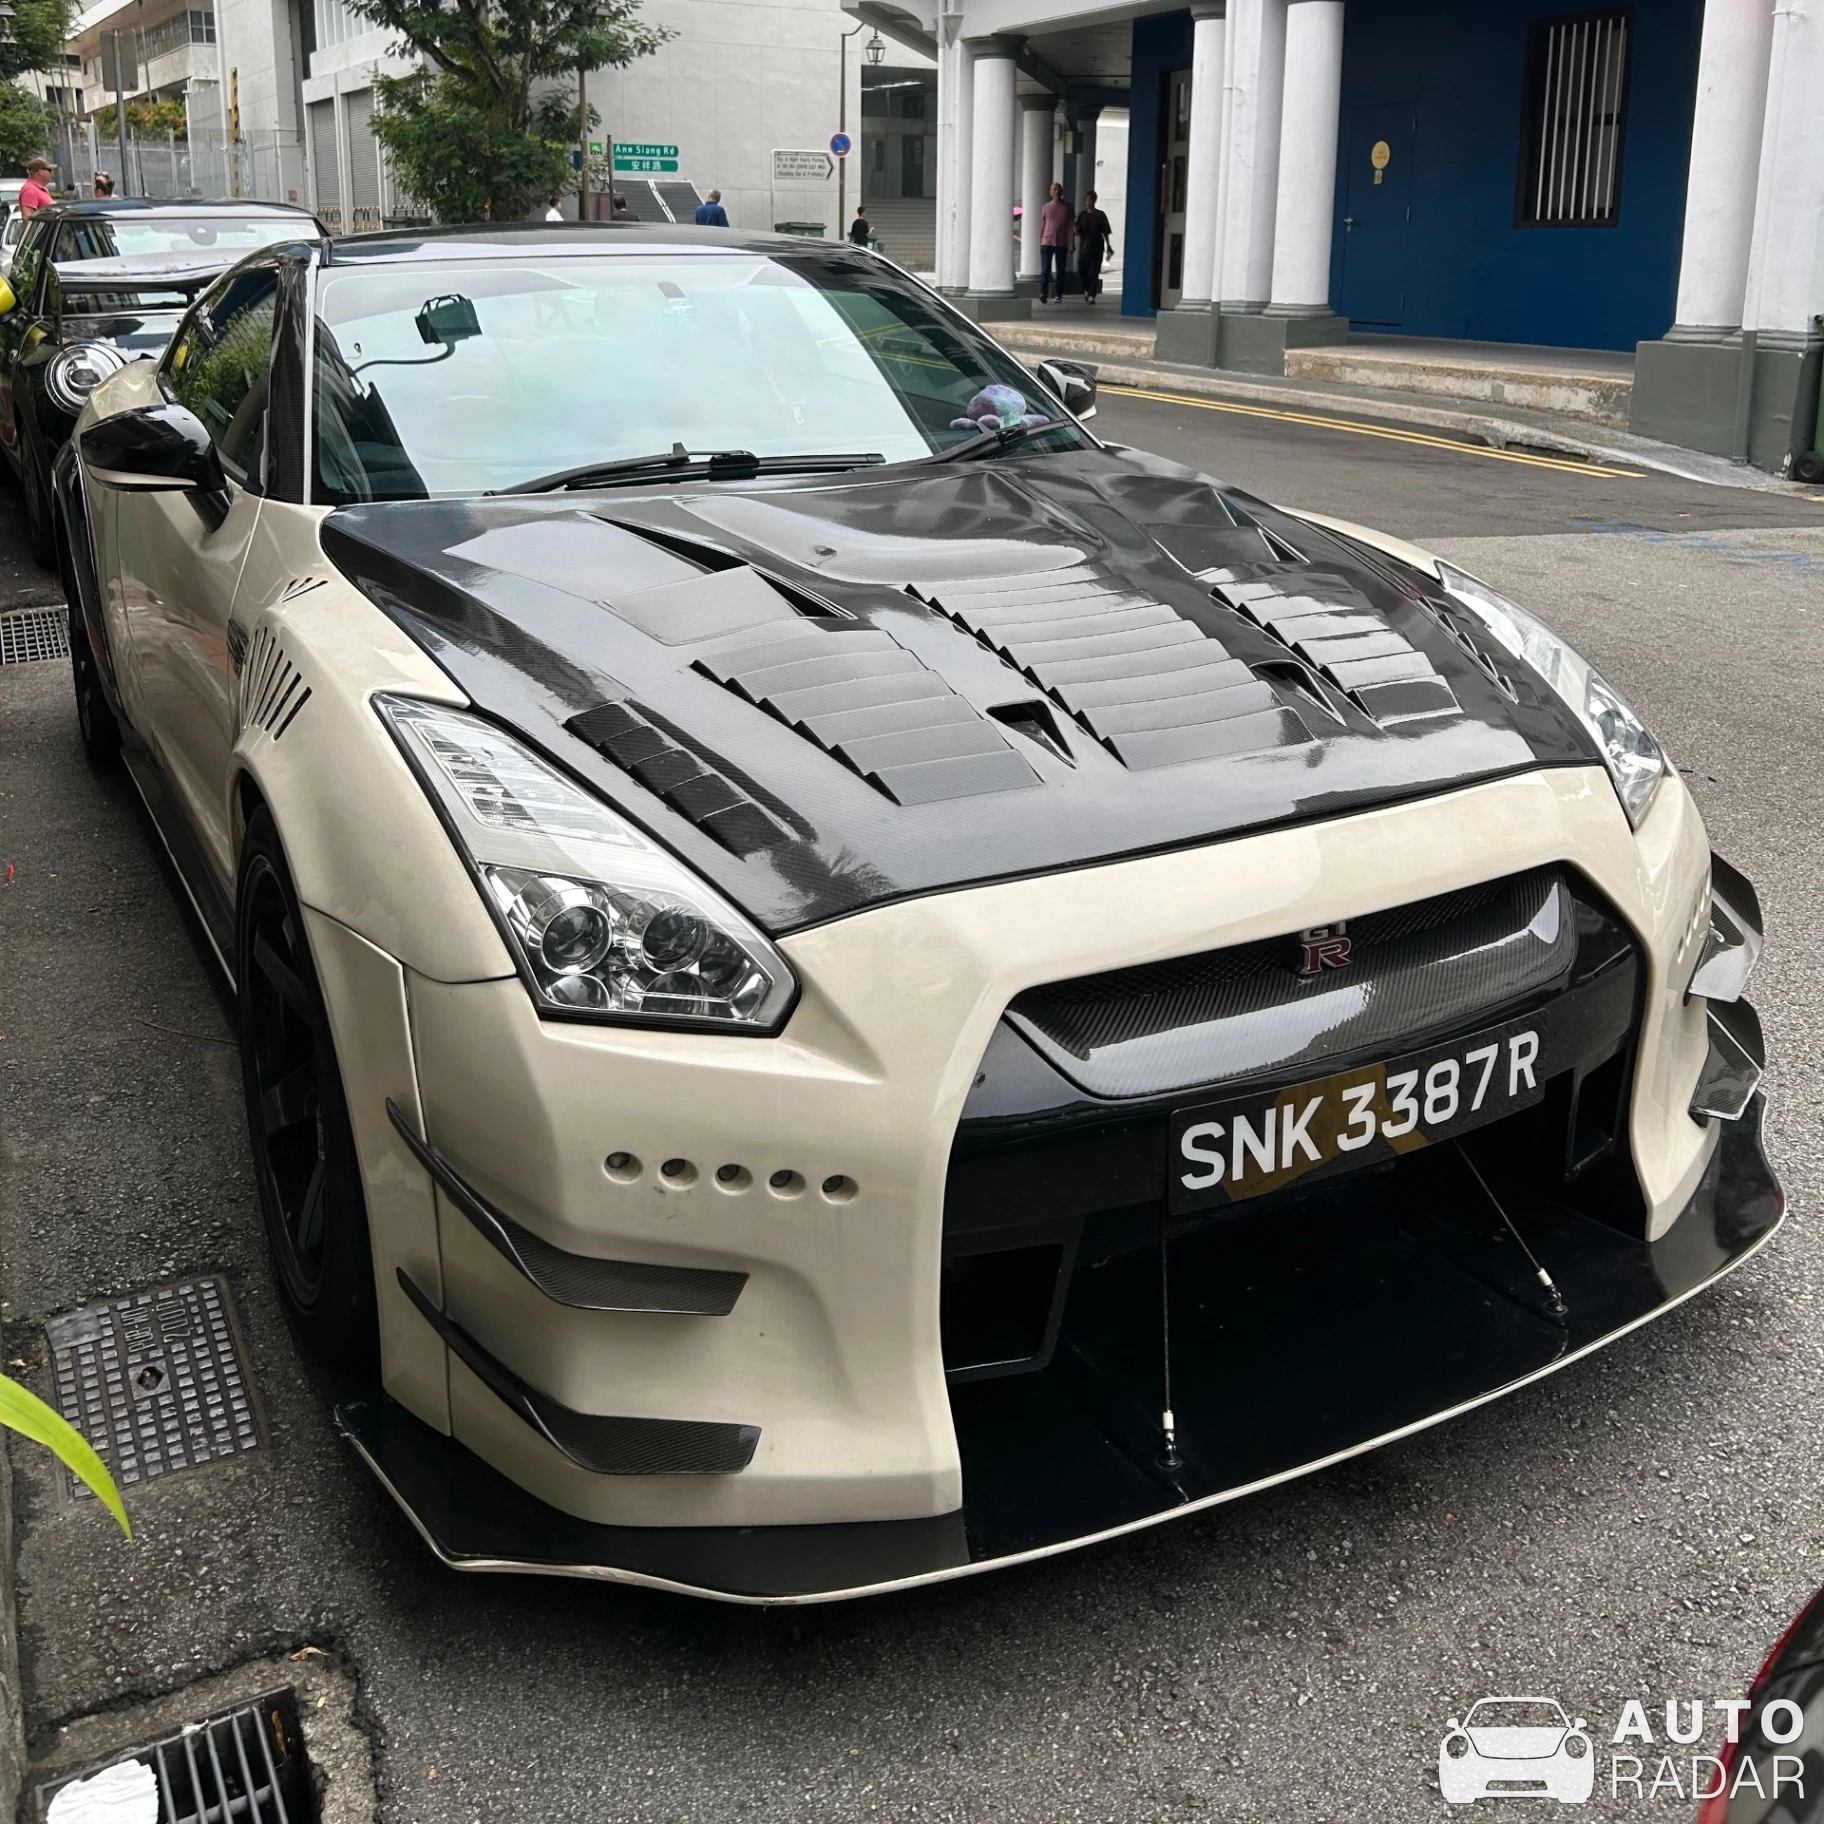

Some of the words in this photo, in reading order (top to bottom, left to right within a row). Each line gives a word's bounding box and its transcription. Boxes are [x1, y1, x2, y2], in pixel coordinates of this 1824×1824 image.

[615, 144, 633, 154] Ann
[636, 145, 661, 157] Siang
[663, 146, 675, 155] Rd
[631, 160, 662, 171] 安祥路
[1180, 1096, 1324, 1191] SNK
